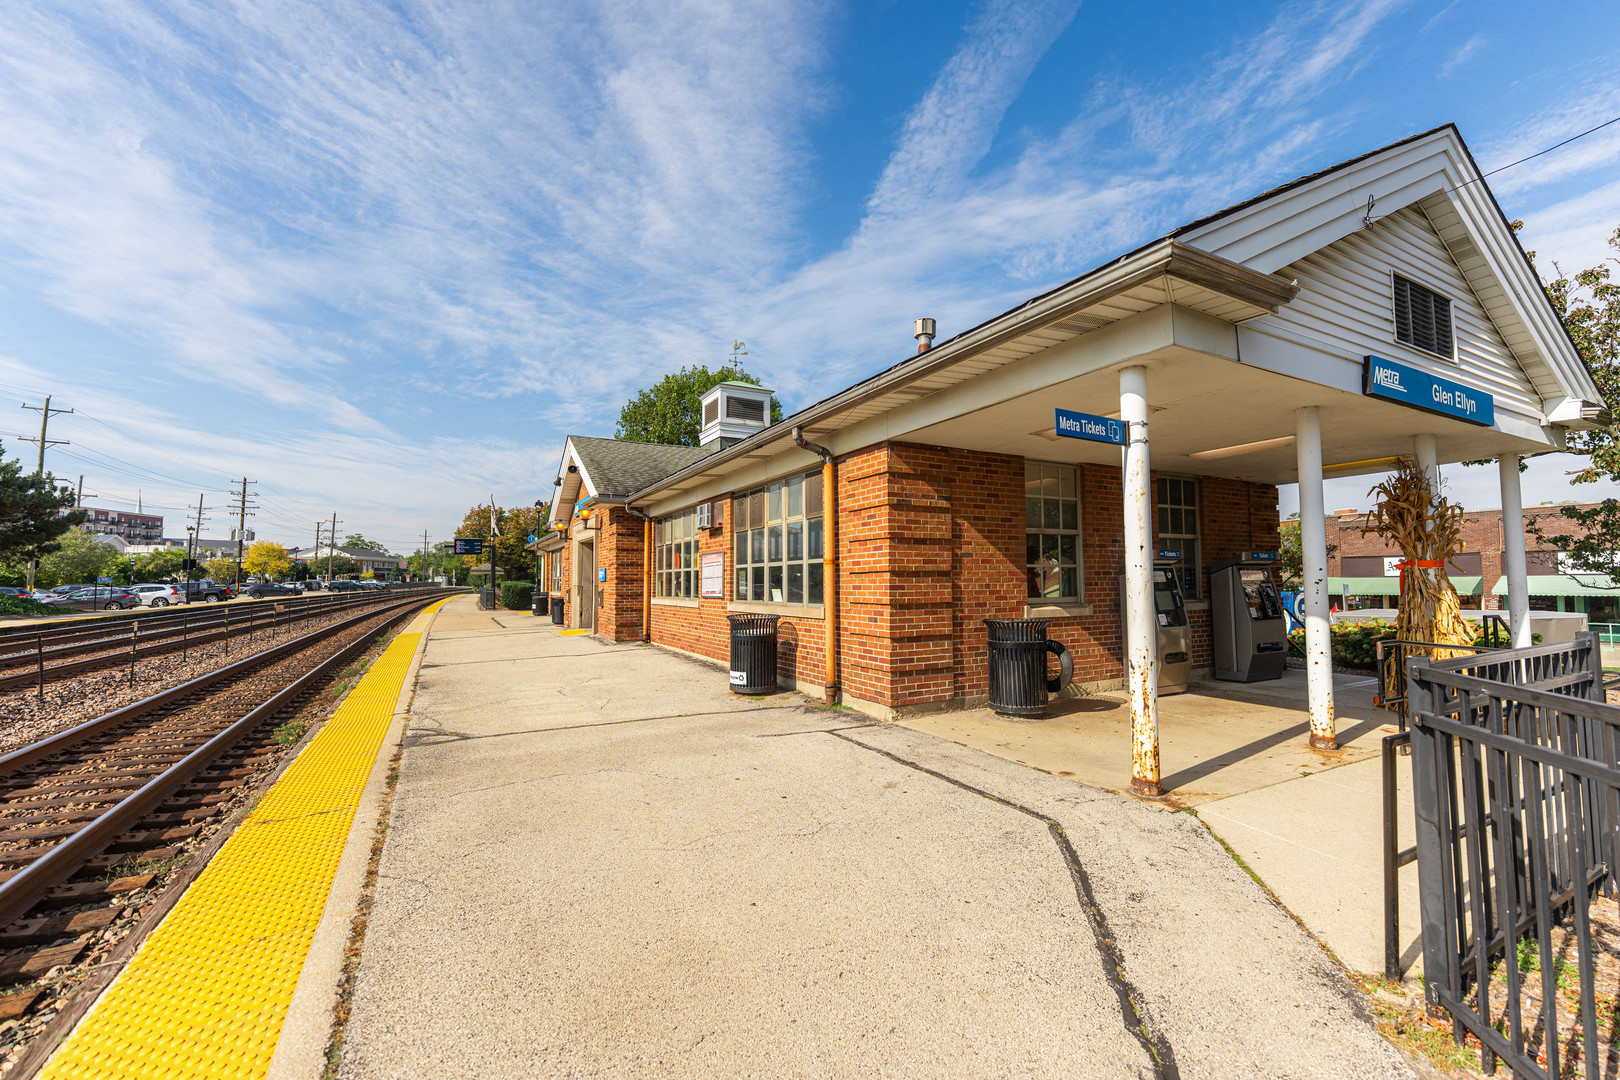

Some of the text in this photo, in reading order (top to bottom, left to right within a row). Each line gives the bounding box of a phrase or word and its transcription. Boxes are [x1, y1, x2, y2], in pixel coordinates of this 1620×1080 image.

[1374, 366, 1400, 386] Metra
[1432, 384, 1476, 415] Glen Ellyn
[1059, 416, 1106, 436] Metra Tickets
